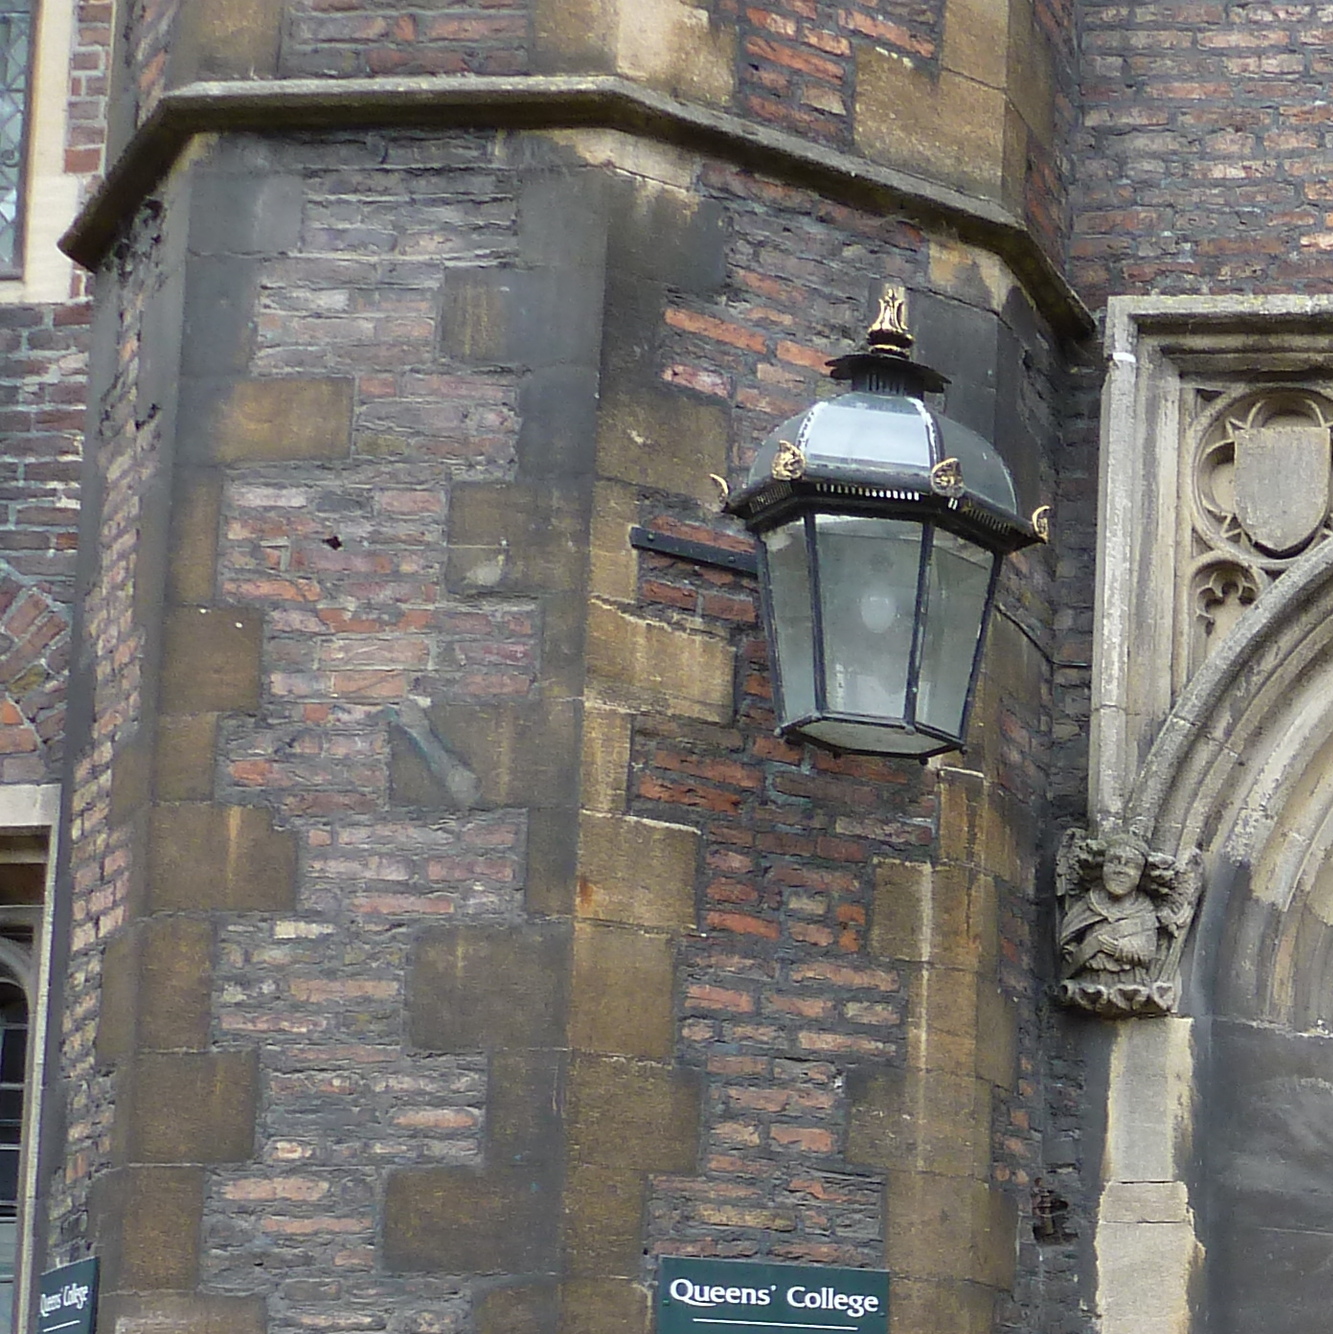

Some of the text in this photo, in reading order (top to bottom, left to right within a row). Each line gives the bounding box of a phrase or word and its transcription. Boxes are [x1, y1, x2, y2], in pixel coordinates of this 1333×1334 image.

[63, 1283, 88, 1309] College
[670, 1279, 879, 1317] Queens' College
